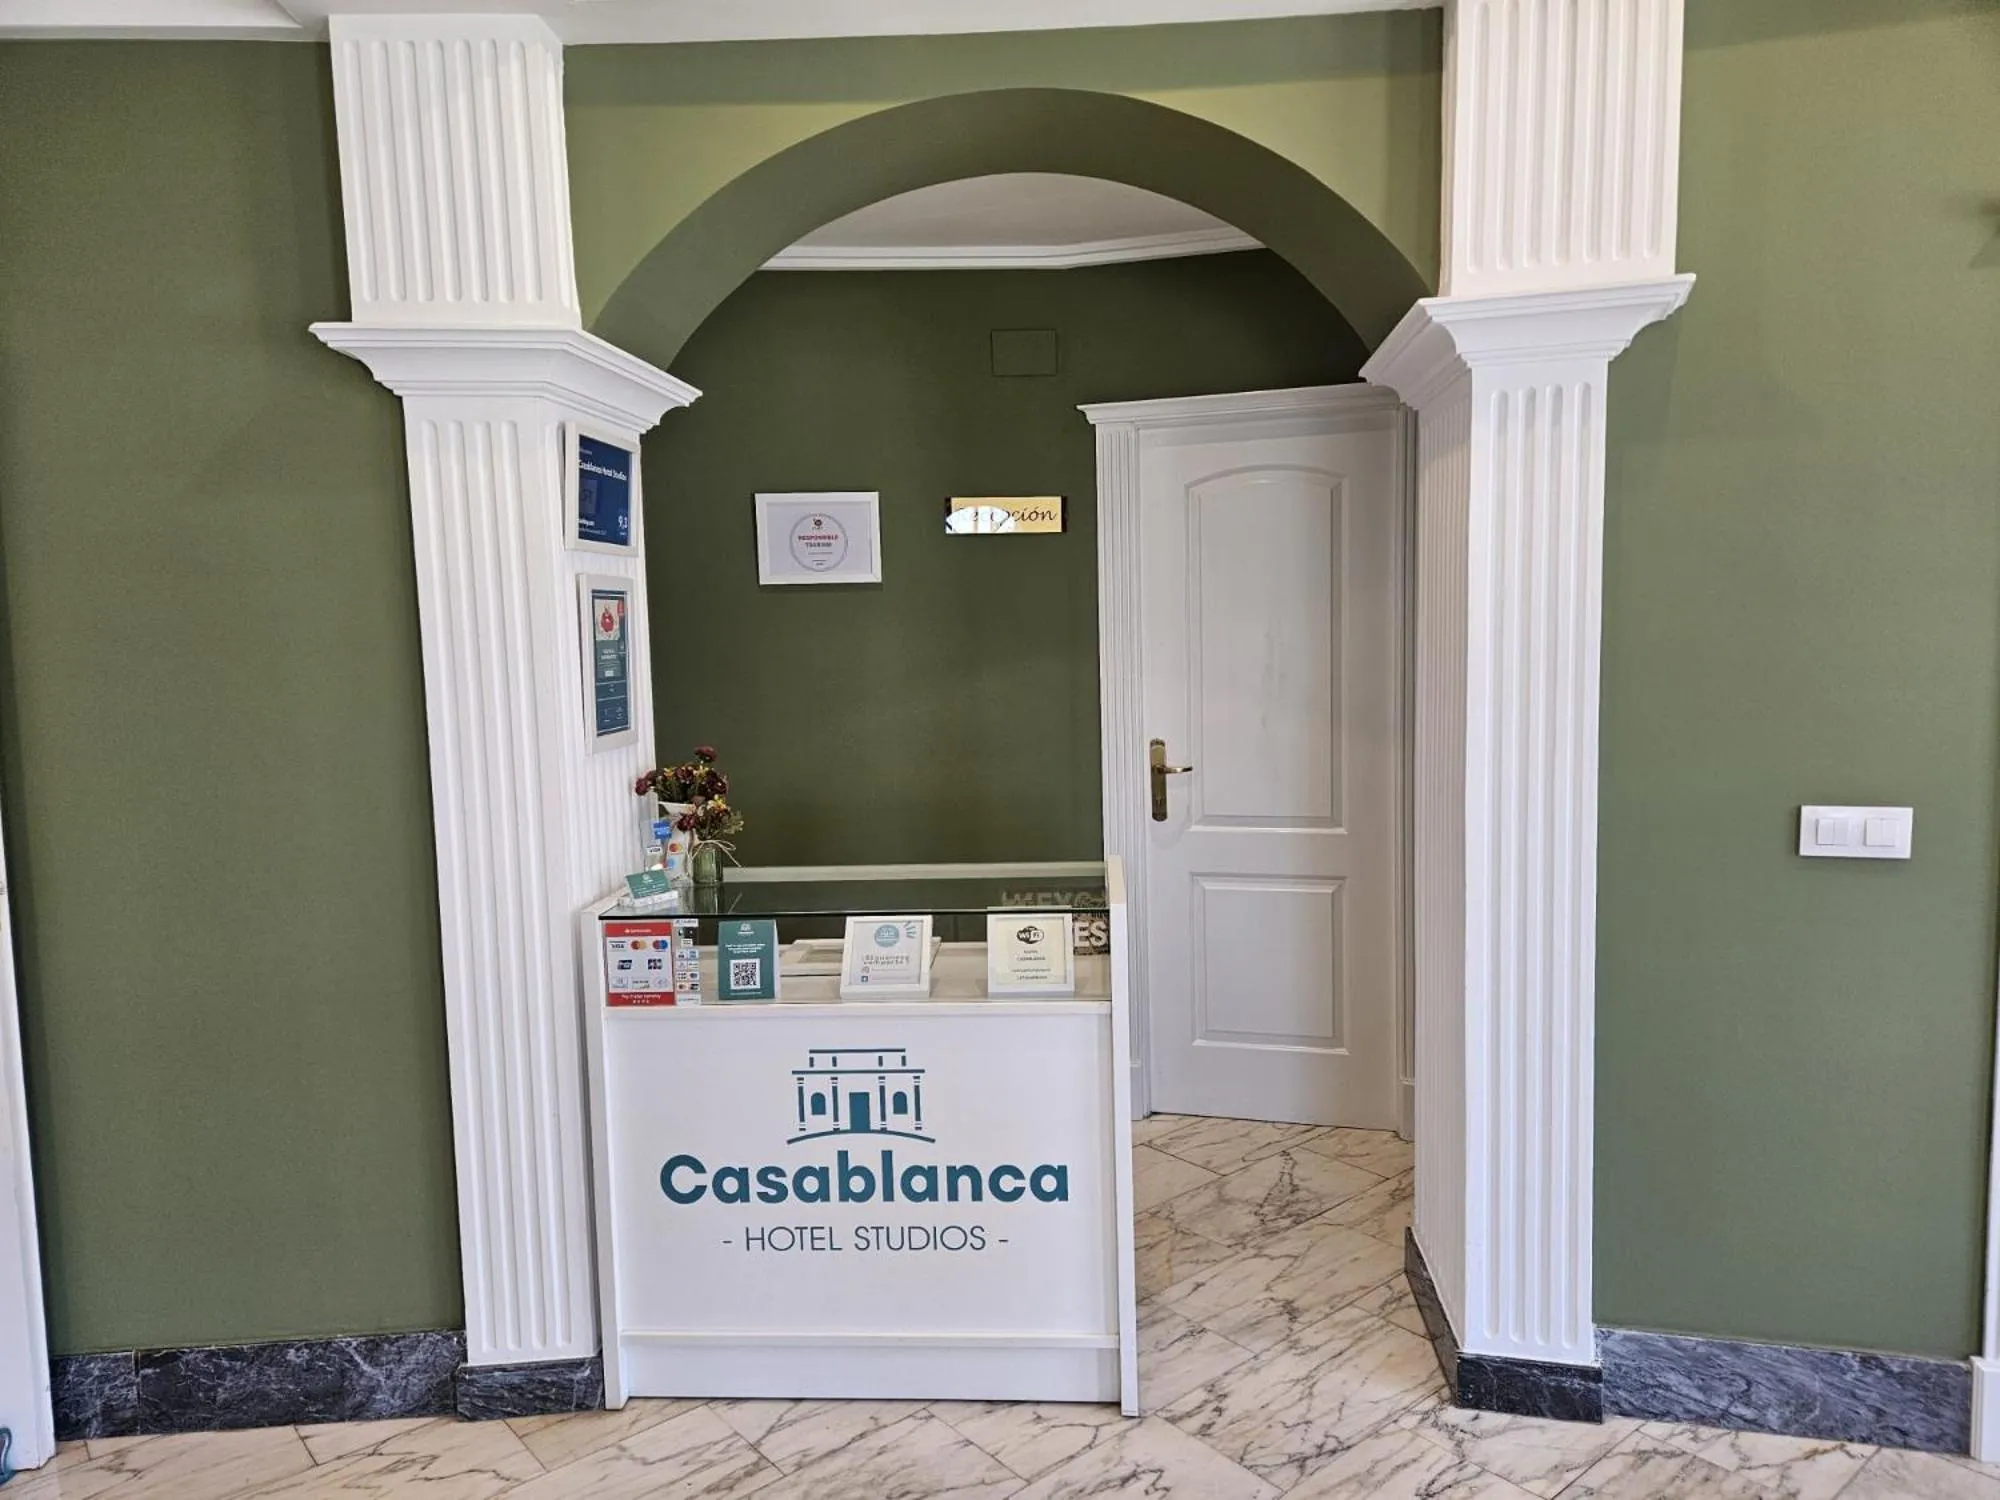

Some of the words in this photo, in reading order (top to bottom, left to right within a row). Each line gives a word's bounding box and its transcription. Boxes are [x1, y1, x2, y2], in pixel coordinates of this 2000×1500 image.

[660, 1149, 1070, 1205] Casablanca
[745, 1226, 843, 1252] HOTEL
[854, 1225, 986, 1252] STUDIOS
